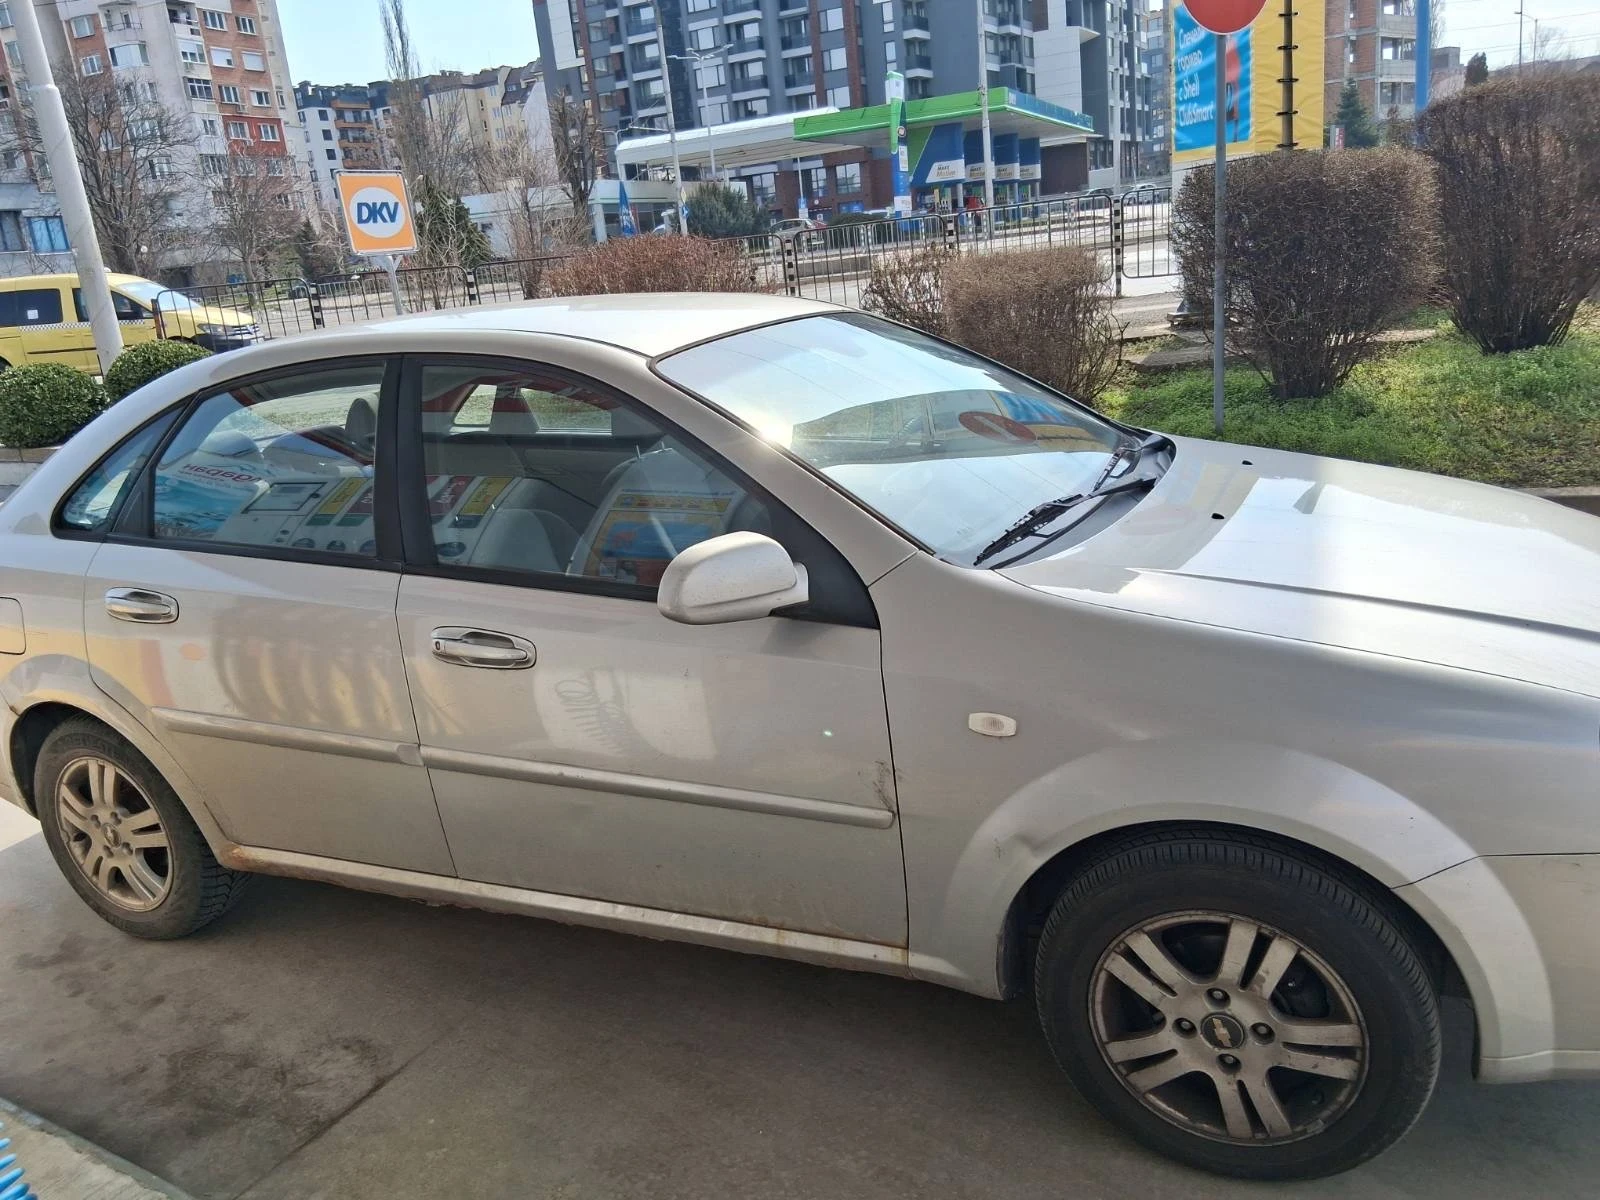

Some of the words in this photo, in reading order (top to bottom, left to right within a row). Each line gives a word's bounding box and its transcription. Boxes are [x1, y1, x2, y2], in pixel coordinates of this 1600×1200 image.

[1178, 50, 1203, 72] гориво
[1184, 72, 1200, 101] Shell
[1179, 101, 1214, 126] ClubSmart
[357, 202, 399, 224] DKV
